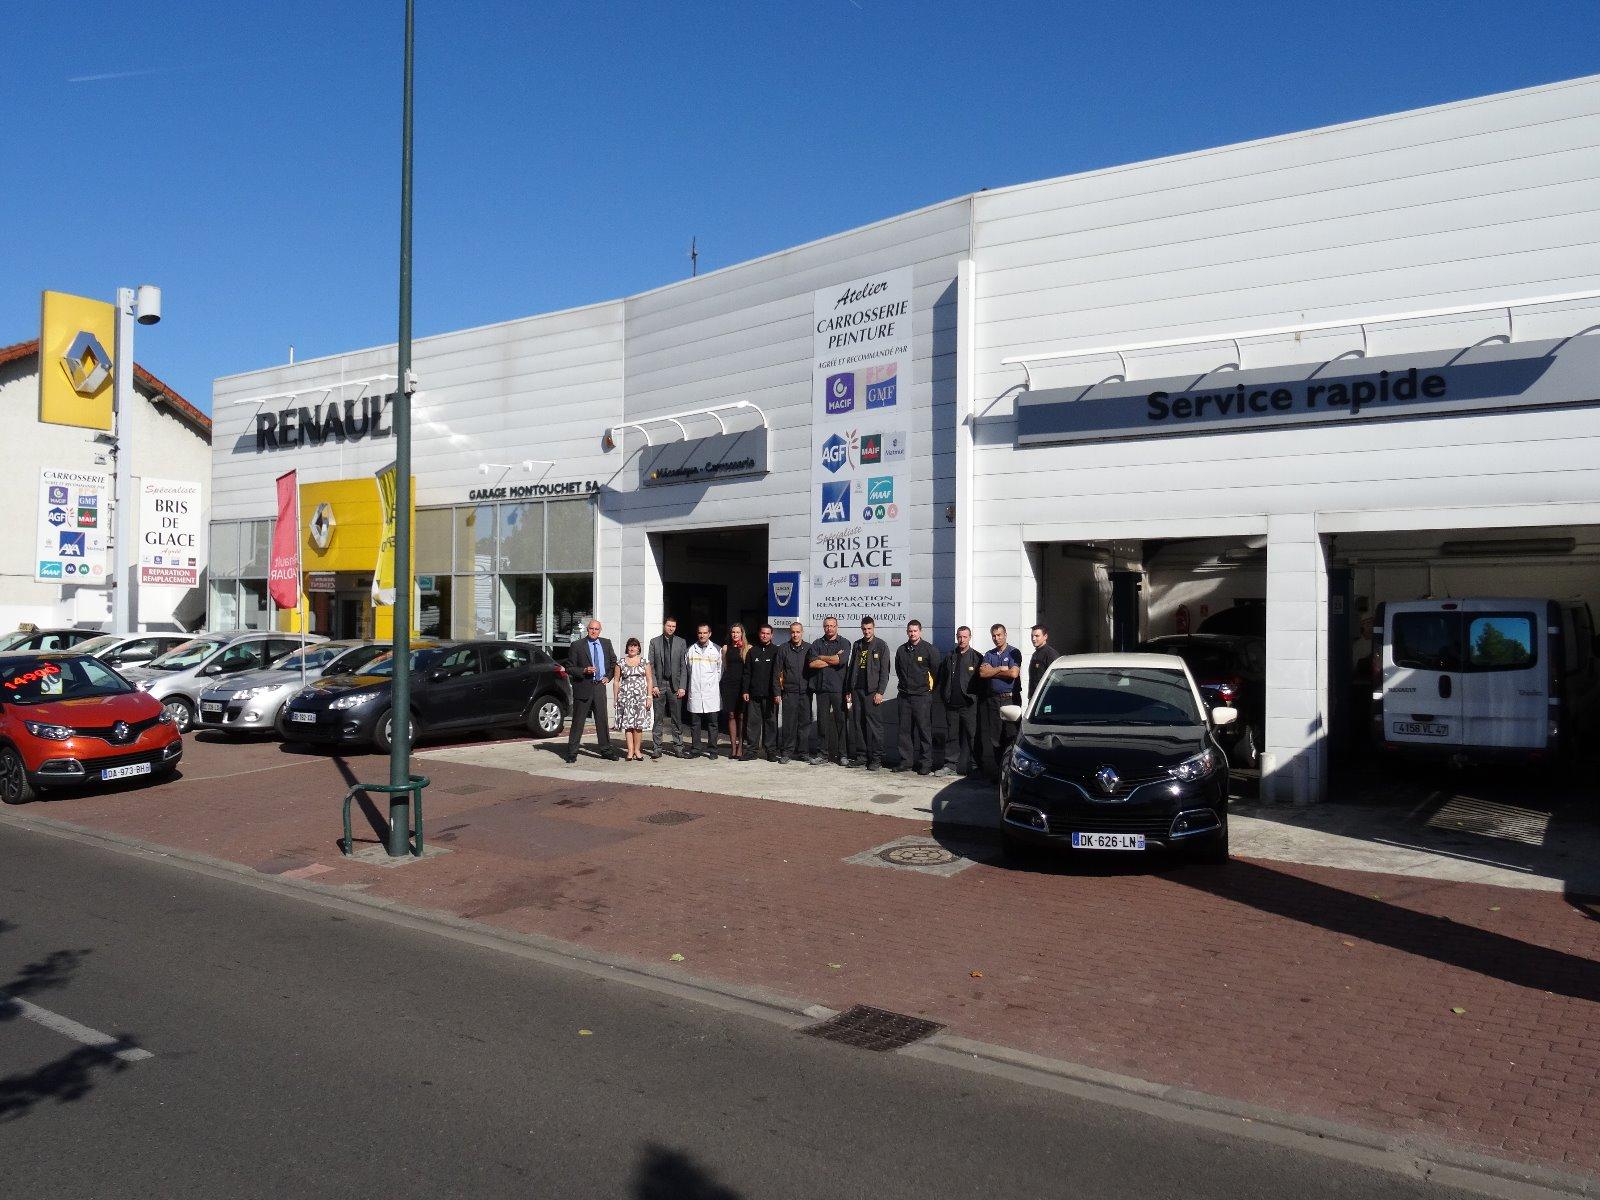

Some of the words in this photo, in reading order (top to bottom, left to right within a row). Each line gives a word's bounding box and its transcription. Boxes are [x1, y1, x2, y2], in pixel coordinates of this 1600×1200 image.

[834, 281, 888, 310] Atelier
[817, 300, 908, 333] CARROSSERIE
[828, 322, 896, 349] PEINTURE
[838, 357, 846, 365] ET
[895, 345, 908, 355] PAR
[868, 385, 895, 403] GMF
[1147, 383, 1293, 421] Service
[1306, 368, 1447, 416] rapide
[828, 398, 852, 411] MACIF
[822, 444, 847, 463] AGF
[861, 447, 880, 456] MAIF
[43, 471, 106, 484] CARROSSERIE
[469, 487, 507, 500] GARAGE
[509, 481, 582, 498] MONTOUCHET
[585, 480, 600, 493] SA
[79, 496, 97, 505] GMF
[155, 499, 188, 514] BRIS
[48, 512, 66, 522] AGF
[821, 501, 846, 520] AXA
[162, 517, 179, 528] DE
[145, 531, 195, 547] GLACE
[826, 536, 861, 552] BRIS
[866, 535, 889, 549] DE
[59, 544, 81, 555] AXA
[823, 550, 893, 569] GLACE
[142, 575, 196, 584] REMPLACEMENT
[148, 569, 191, 577] REPARATION
[873, 613, 906, 622] MARQUES
[1080, 834, 1136, 848] DK-626-LN
